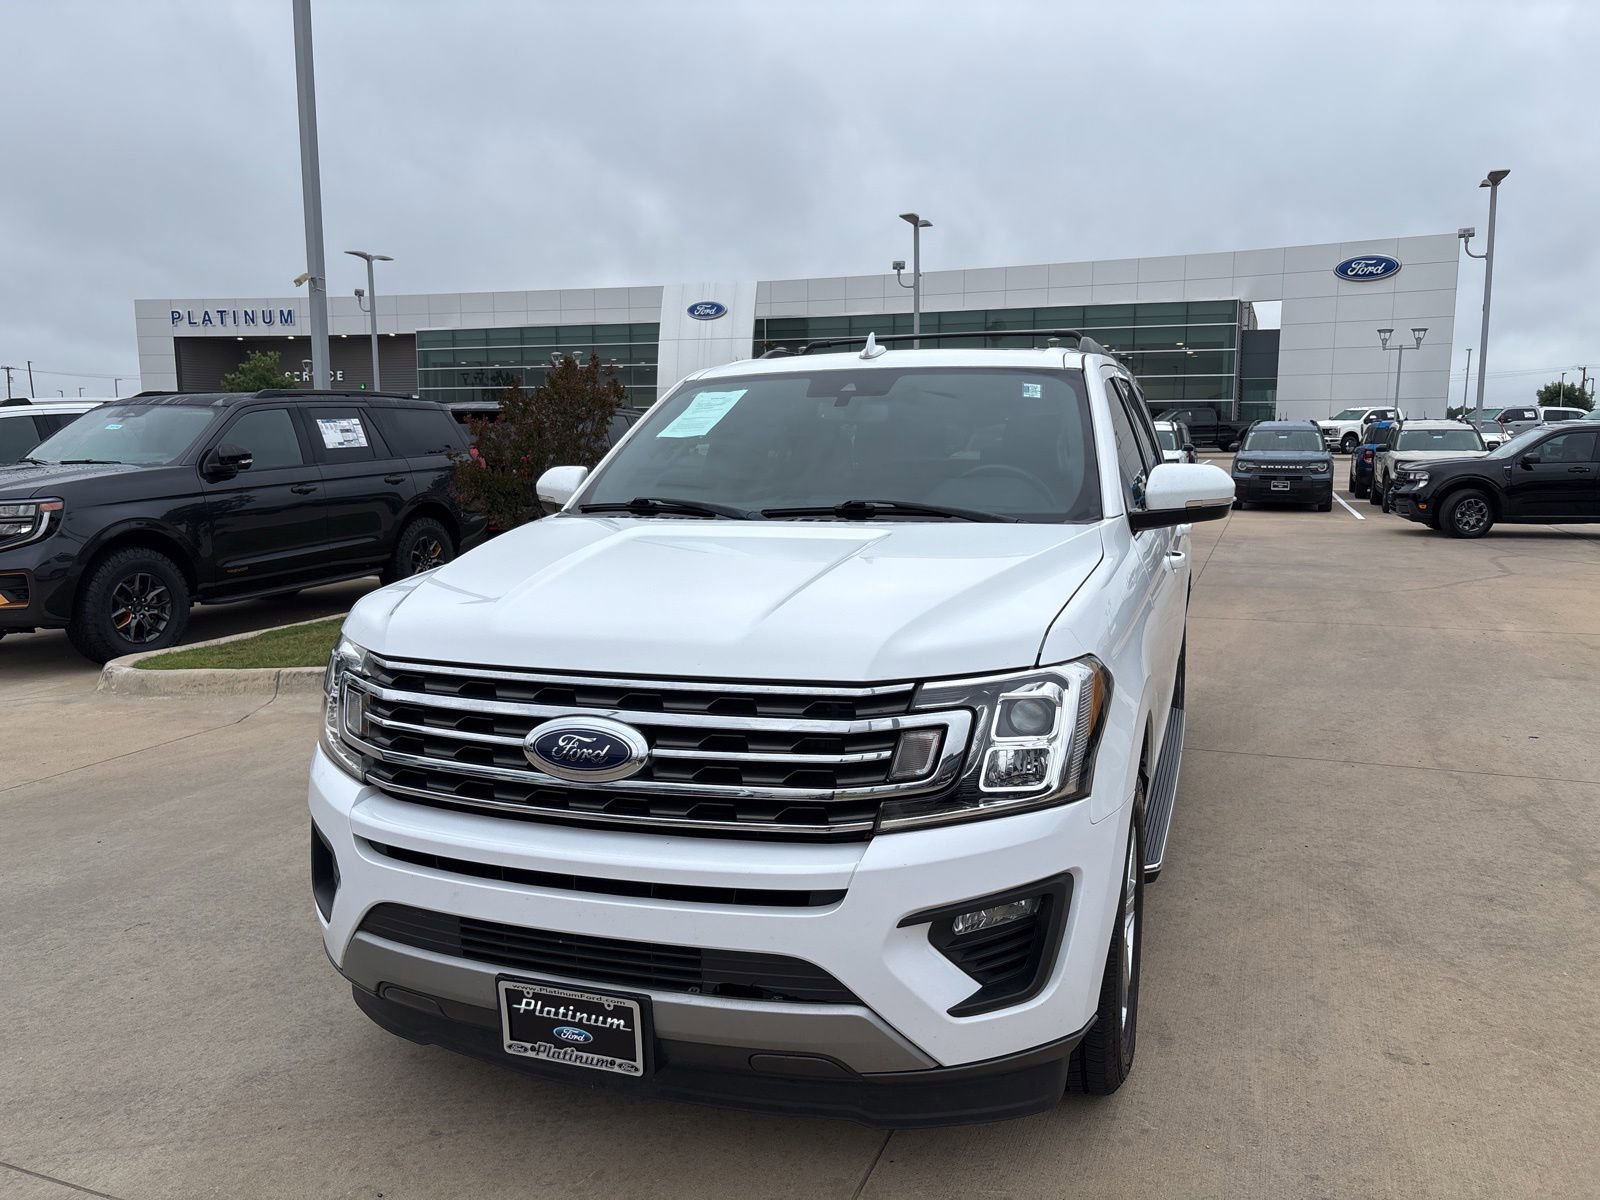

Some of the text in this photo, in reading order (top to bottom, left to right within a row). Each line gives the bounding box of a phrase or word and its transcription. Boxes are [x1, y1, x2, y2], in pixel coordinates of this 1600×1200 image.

[1347, 260, 1386, 276] Ford
[170, 309, 295, 326] PLATINUM
[694, 304, 717, 315] Ford
[284, 371, 343, 381] SERCE
[551, 734, 611, 763] Ford
[512, 984, 626, 1006] www.PlatinumFord.com
[512, 998, 632, 1031] Platinum
[560, 1028, 585, 1042] Ford
